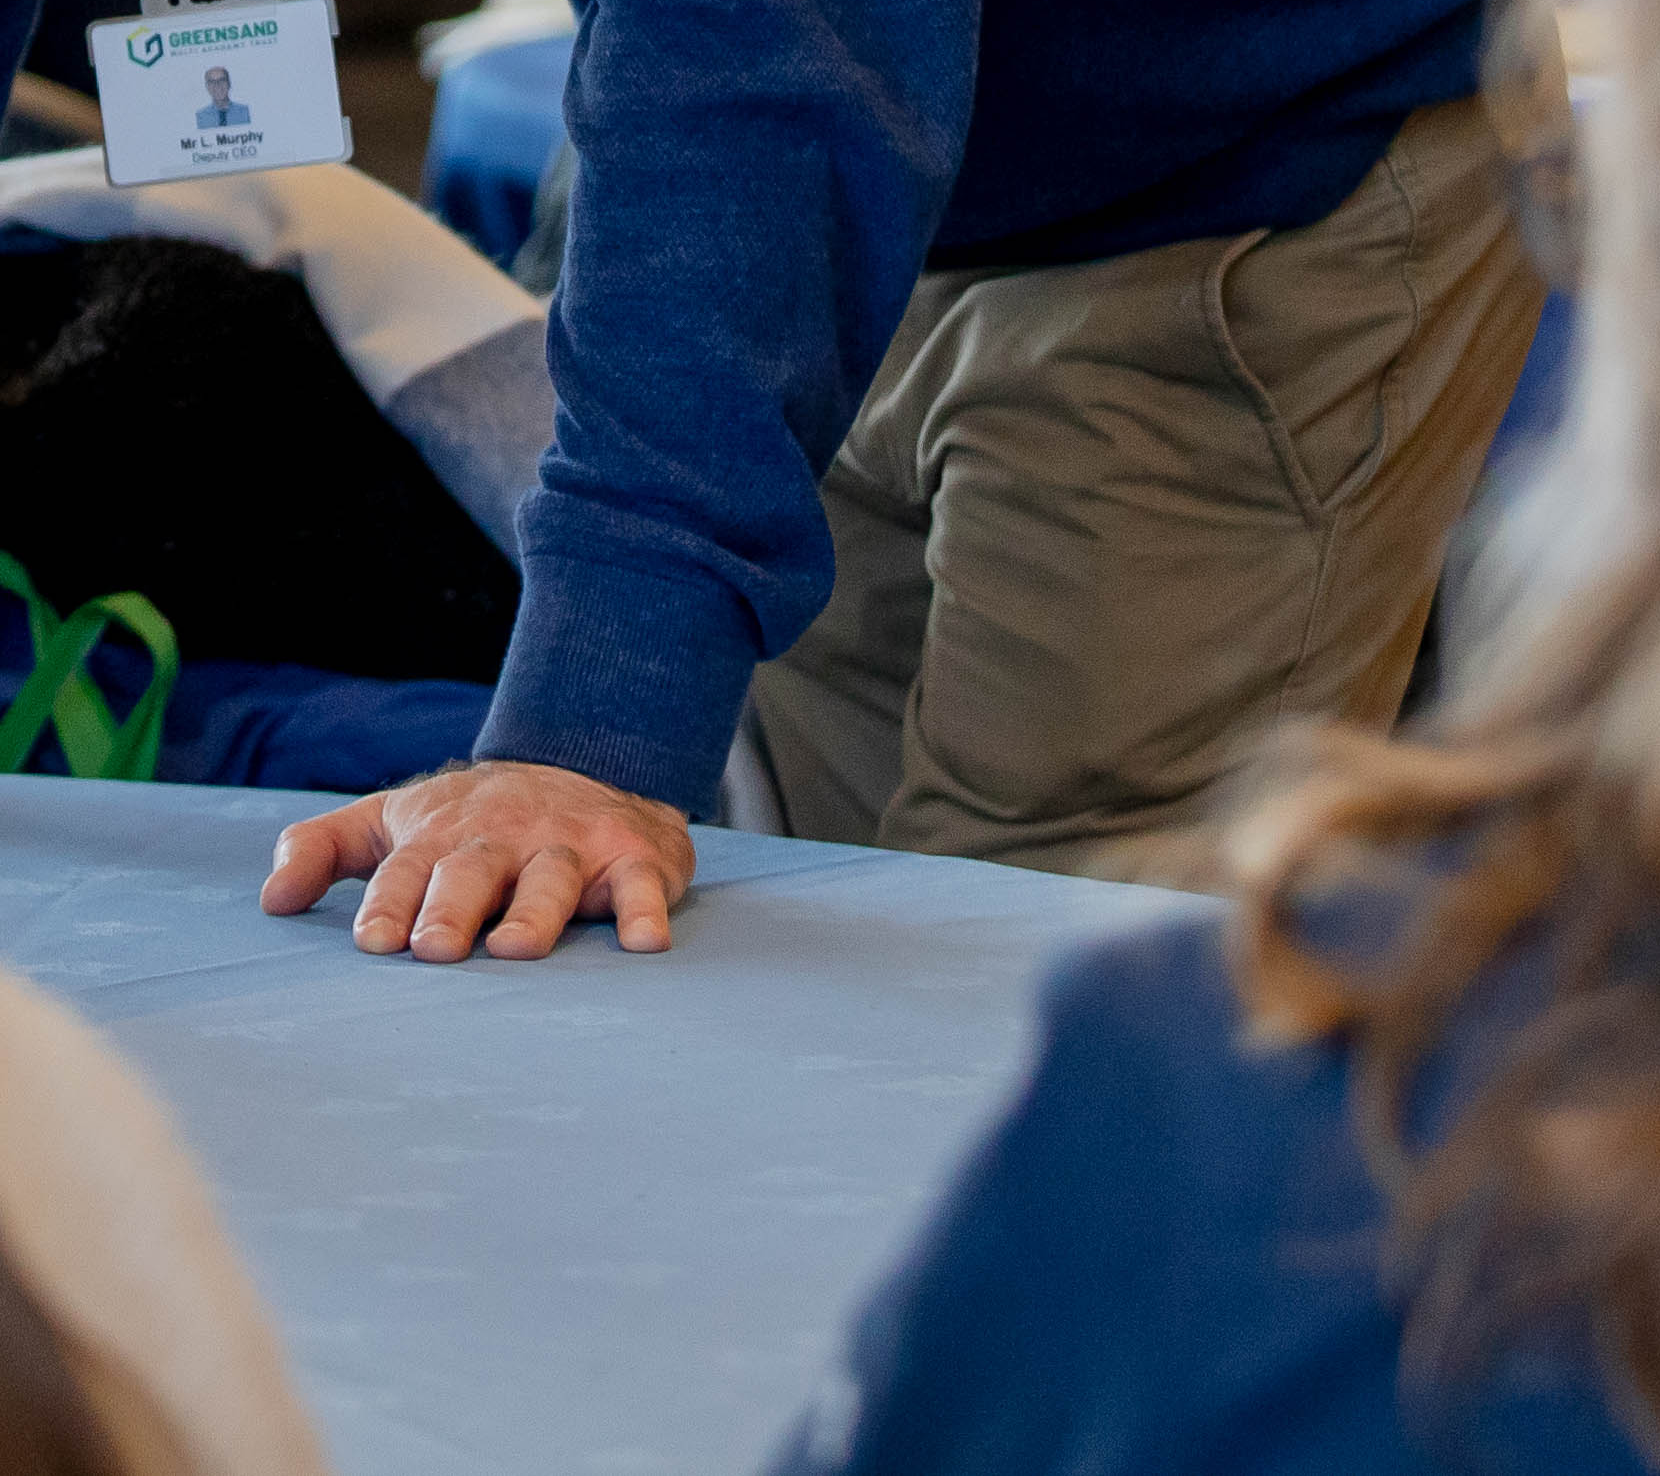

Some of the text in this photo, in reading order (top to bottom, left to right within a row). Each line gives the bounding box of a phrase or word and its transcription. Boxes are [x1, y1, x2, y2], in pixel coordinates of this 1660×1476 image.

[169, 20, 278, 47] GREENSAND
[180, 137, 197, 149] Mr
[216, 131, 263, 146] Murphy
[192, 145, 257, 164] Deputy CEO
